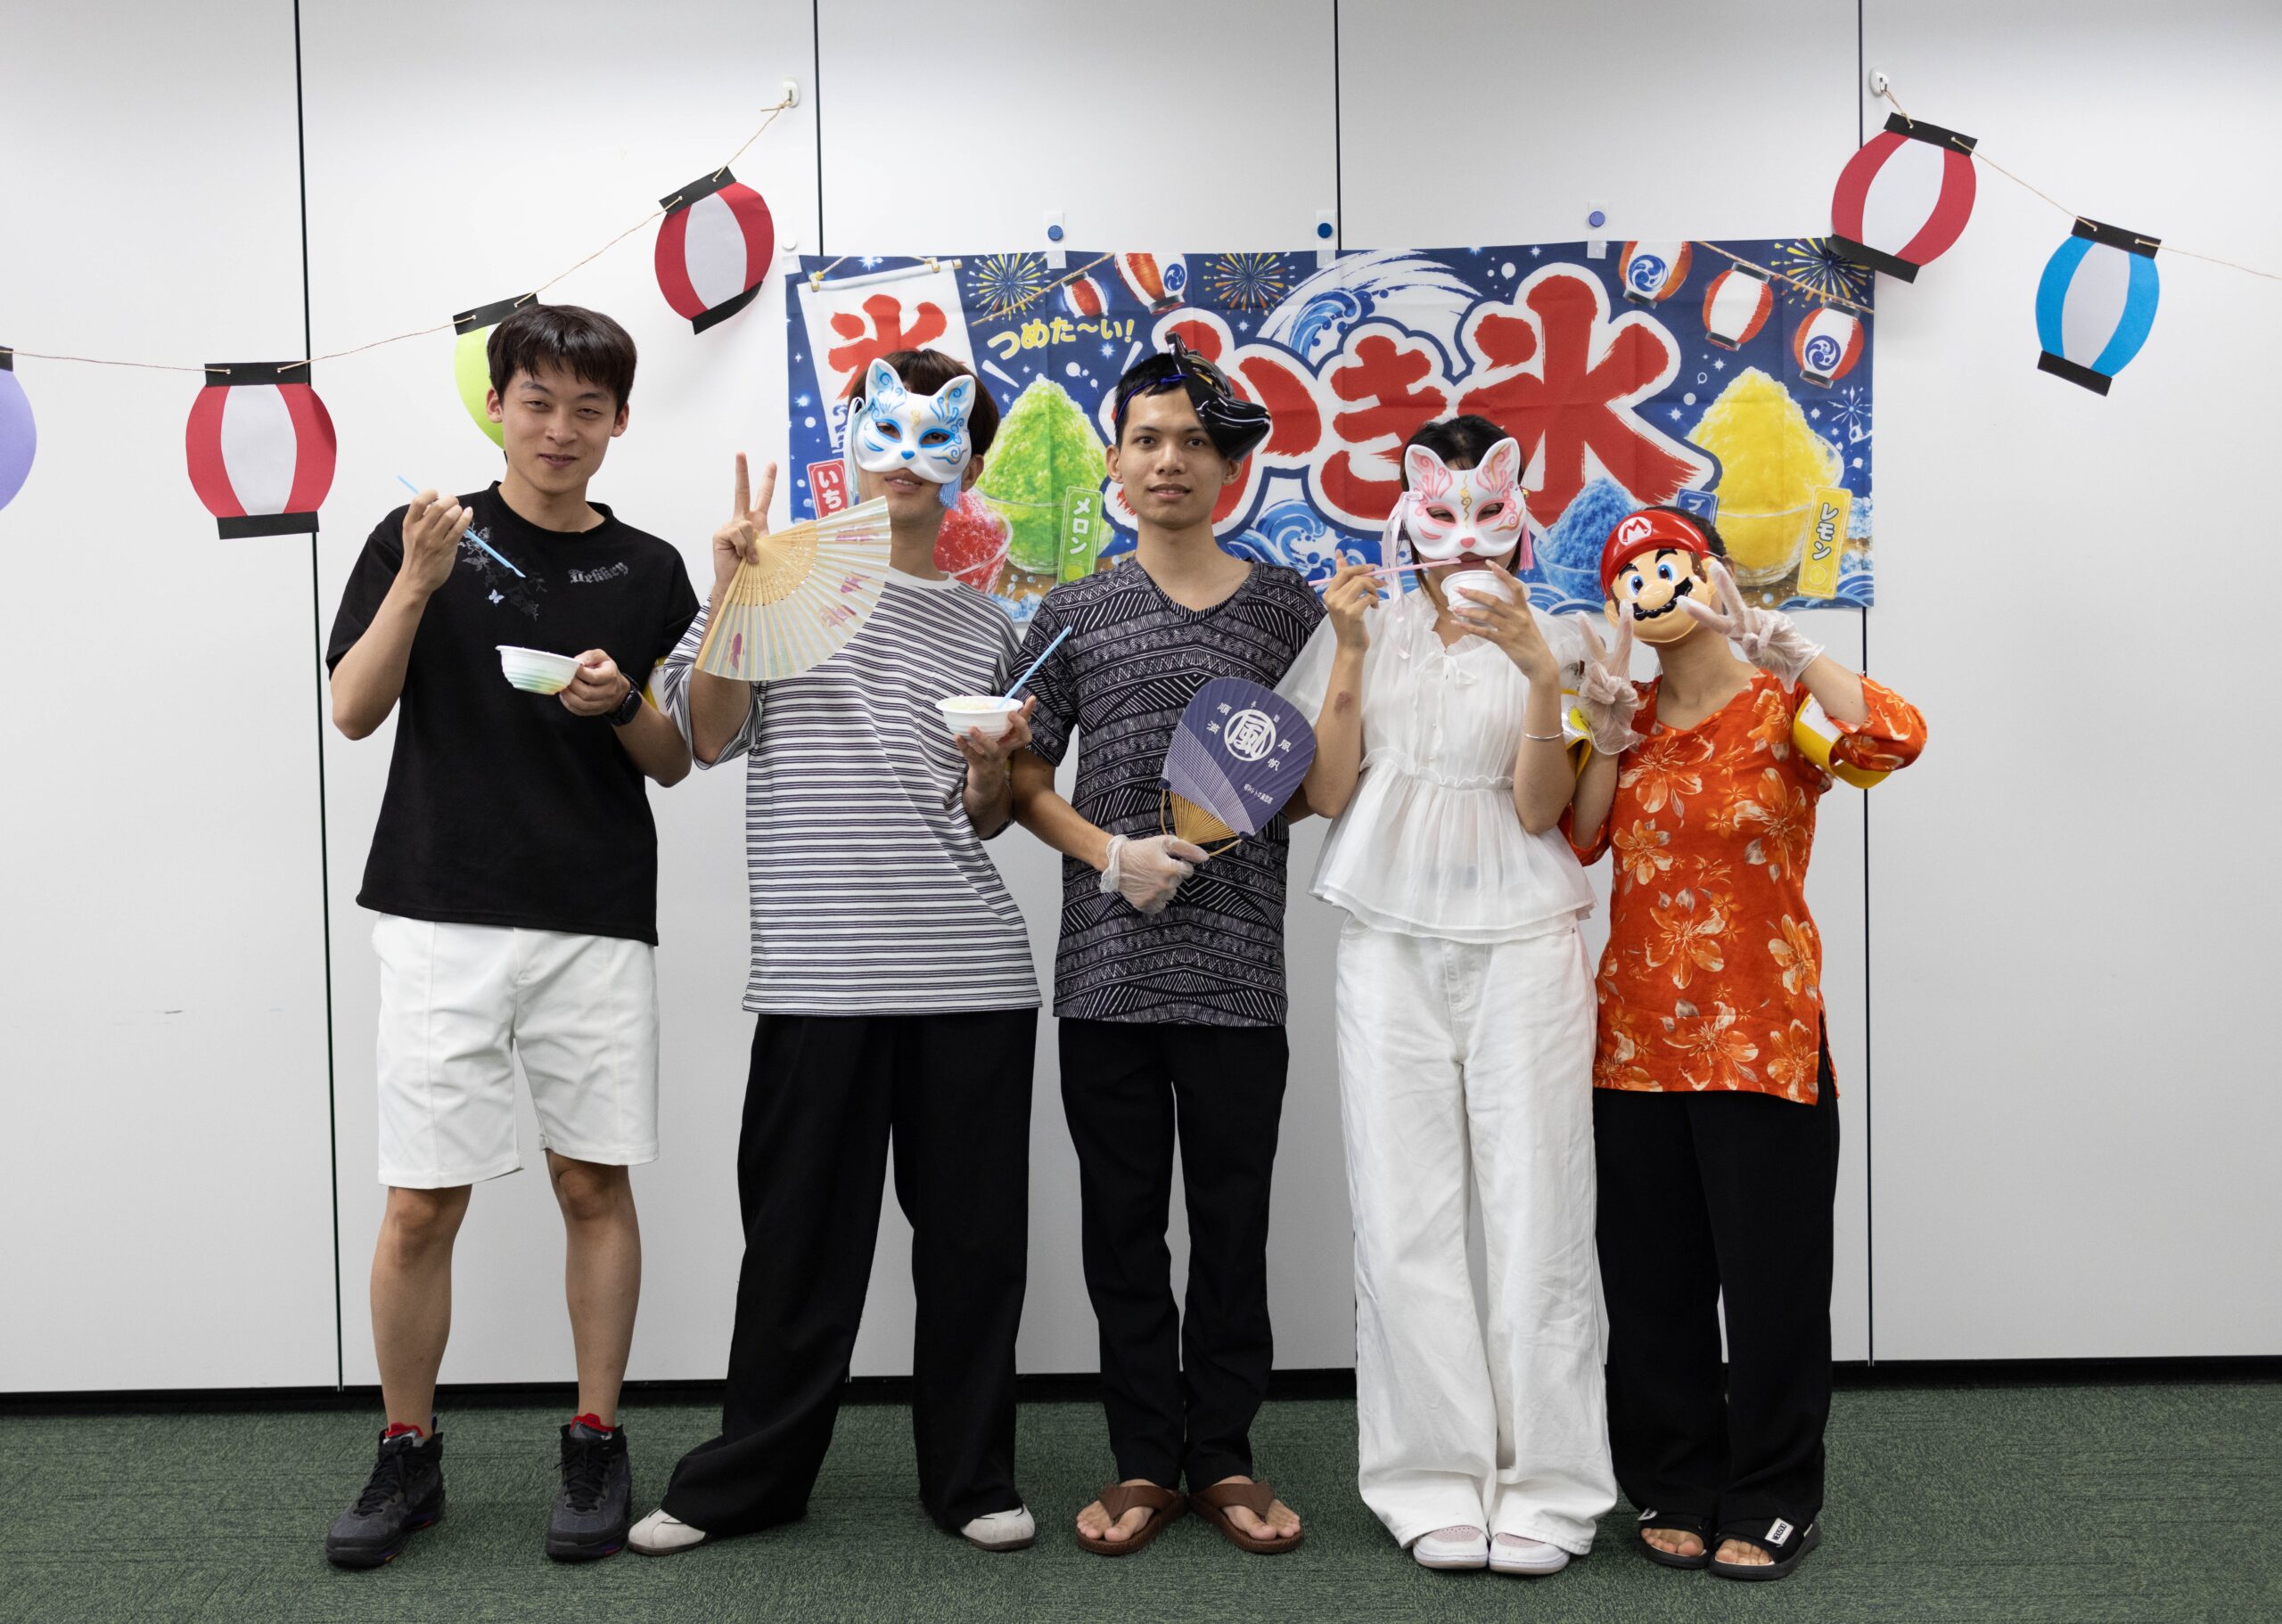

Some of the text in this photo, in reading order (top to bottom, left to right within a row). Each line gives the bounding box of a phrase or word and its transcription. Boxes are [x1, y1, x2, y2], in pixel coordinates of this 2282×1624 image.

[817, 470, 846, 516] いち
[1069, 497, 1091, 554] メロン
[1622, 519, 1650, 543] M
[1812, 502, 1839, 561] レモン
